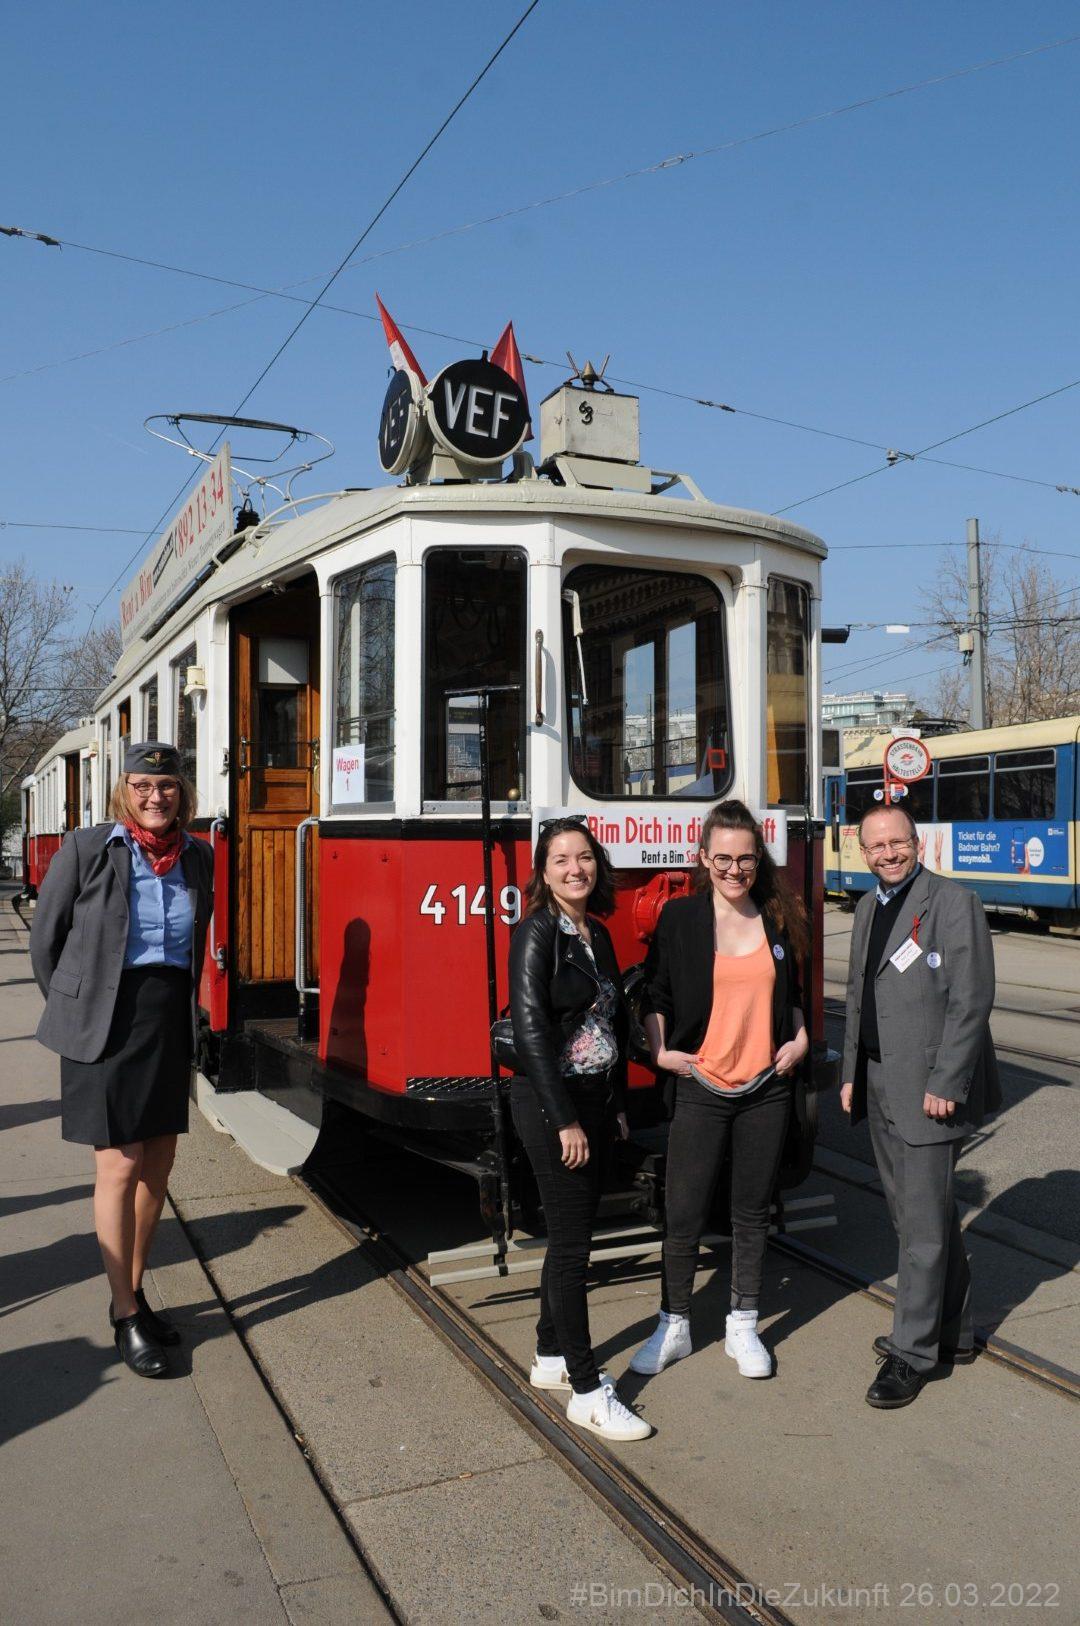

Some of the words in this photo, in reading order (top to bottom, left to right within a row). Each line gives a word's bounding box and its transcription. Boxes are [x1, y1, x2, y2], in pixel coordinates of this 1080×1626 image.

[443, 378, 518, 439] VEF
[178, 505, 194, 557] 892
[211, 461, 224, 517] 34
[336, 757, 359, 774] Wagen
[345, 778, 350, 791] 1
[588, 816, 620, 844] Bim
[625, 816, 662, 844] Dich
[668, 816, 682, 844] in
[687, 816, 703, 844] di
[958, 831, 975, 841] Ticket
[977, 831, 985, 841] für
[986, 831, 997, 841] die
[958, 843, 980, 852] Badner
[981, 842, 1000, 852] Bahn?
[641, 850, 661, 864] Rent
[662, 853, 667, 864] a
[669, 850, 685, 864] Bim
[420, 884, 522, 925] 4149
